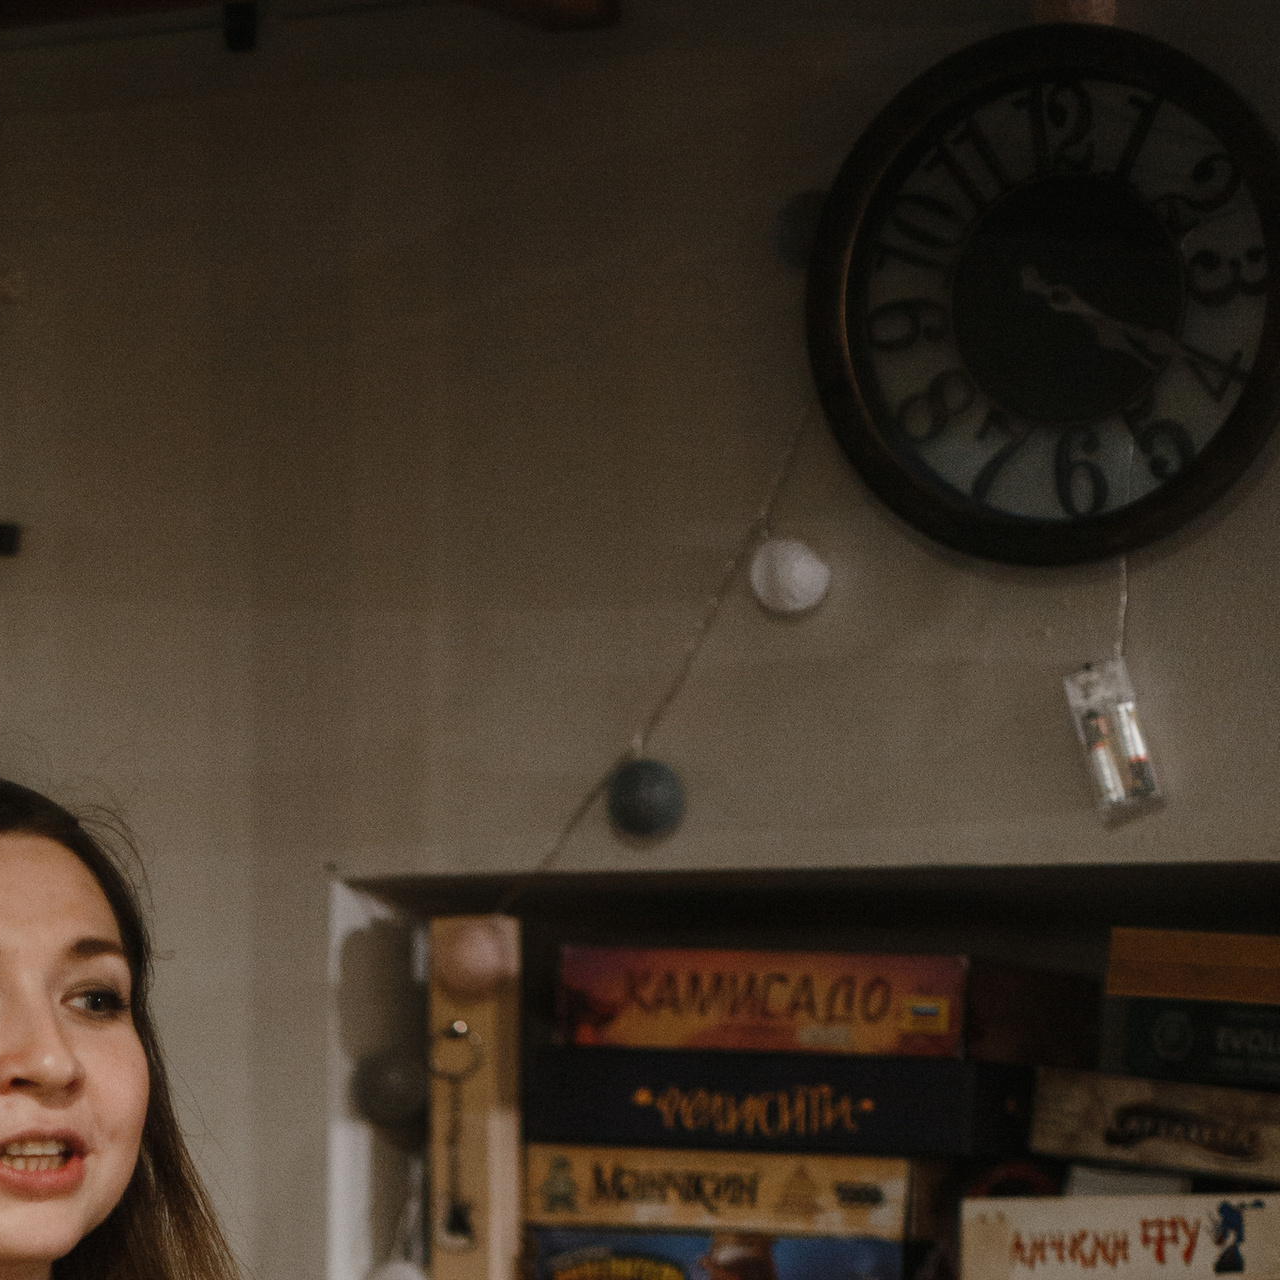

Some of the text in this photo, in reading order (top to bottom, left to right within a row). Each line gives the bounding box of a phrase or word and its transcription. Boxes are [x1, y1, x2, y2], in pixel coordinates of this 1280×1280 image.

[925, 118, 1009, 213] 11
[1013, 82, 1093, 174] 12
[1120, 94, 1164, 177] 1
[872, 191, 959, 271] 10
[1156, 151, 1242, 235] 2
[1184, 245, 1268, 305] 3
[868, 297, 949, 349] 9
[899, 367, 975, 440] 8
[1182, 341, 1250, 402] 4
[971, 408, 1035, 504] 7
[1055, 426, 1108, 517] 6
[1122, 388, 1194, 479] 5
